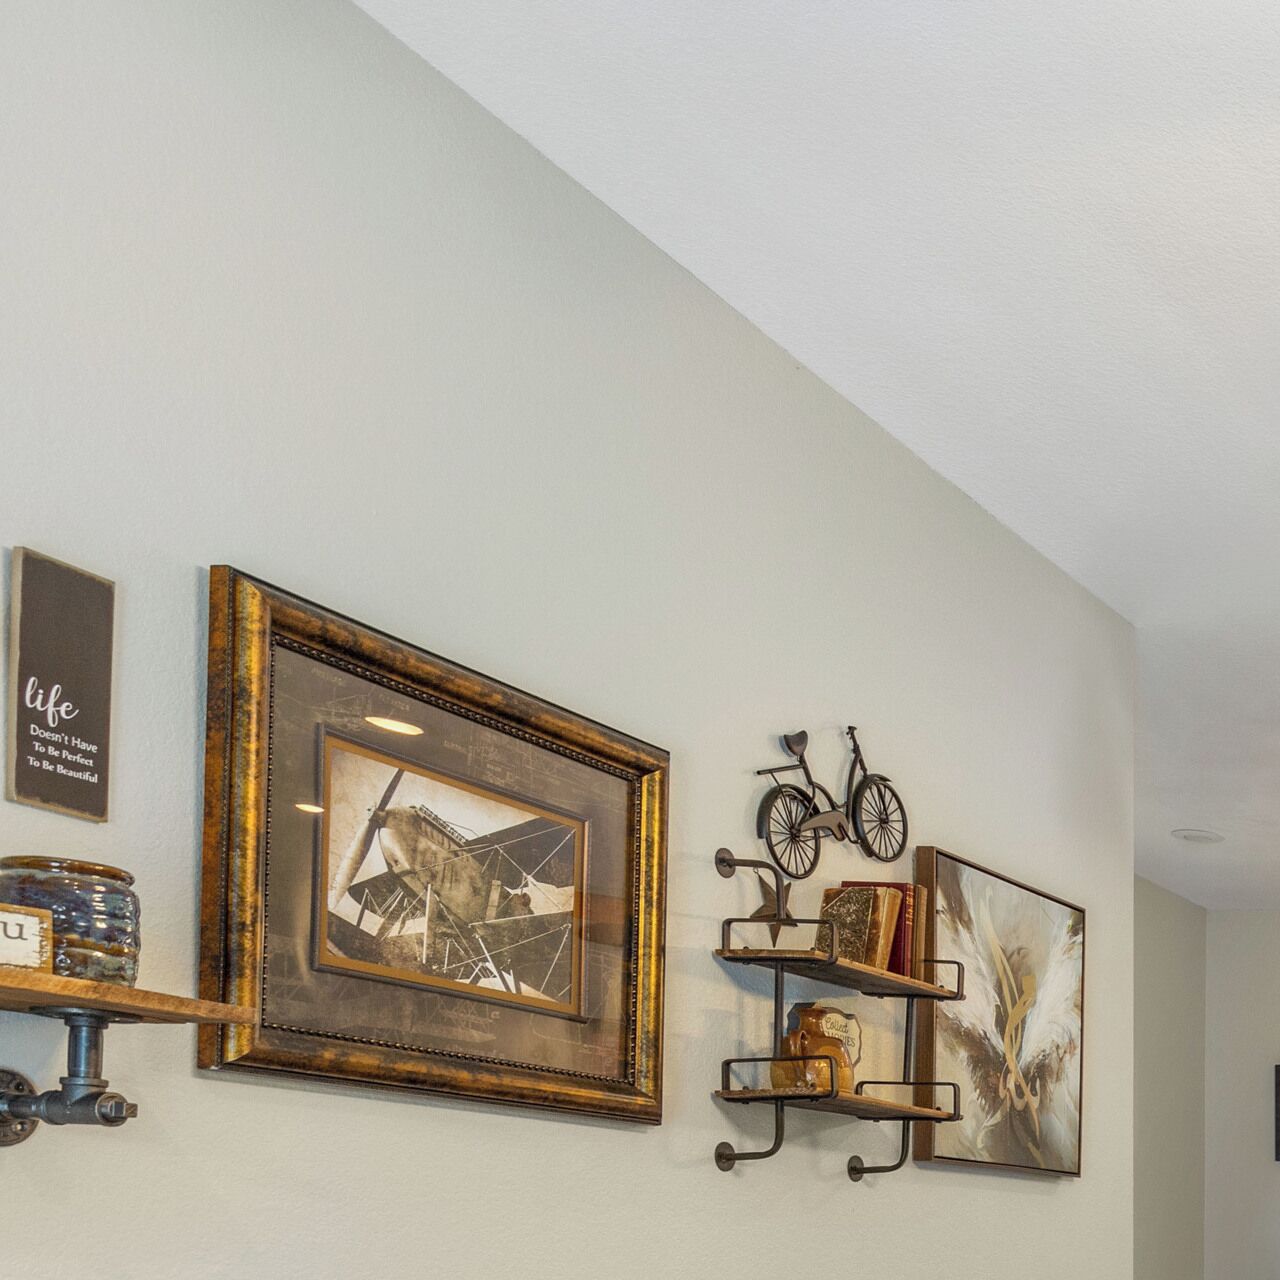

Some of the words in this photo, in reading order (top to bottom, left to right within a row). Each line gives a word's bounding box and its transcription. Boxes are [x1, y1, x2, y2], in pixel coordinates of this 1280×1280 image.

[25, 676, 80, 728] life
[30, 723, 69, 745] Doesn't
[71, 736, 98, 753] Have
[32, 741, 46, 753] To
[47, 745, 60, 757] Be
[62, 750, 94, 767] Perfect
[27, 755, 40, 767] To
[42, 760, 55, 771] Be
[56, 764, 98, 784] Beautiful
